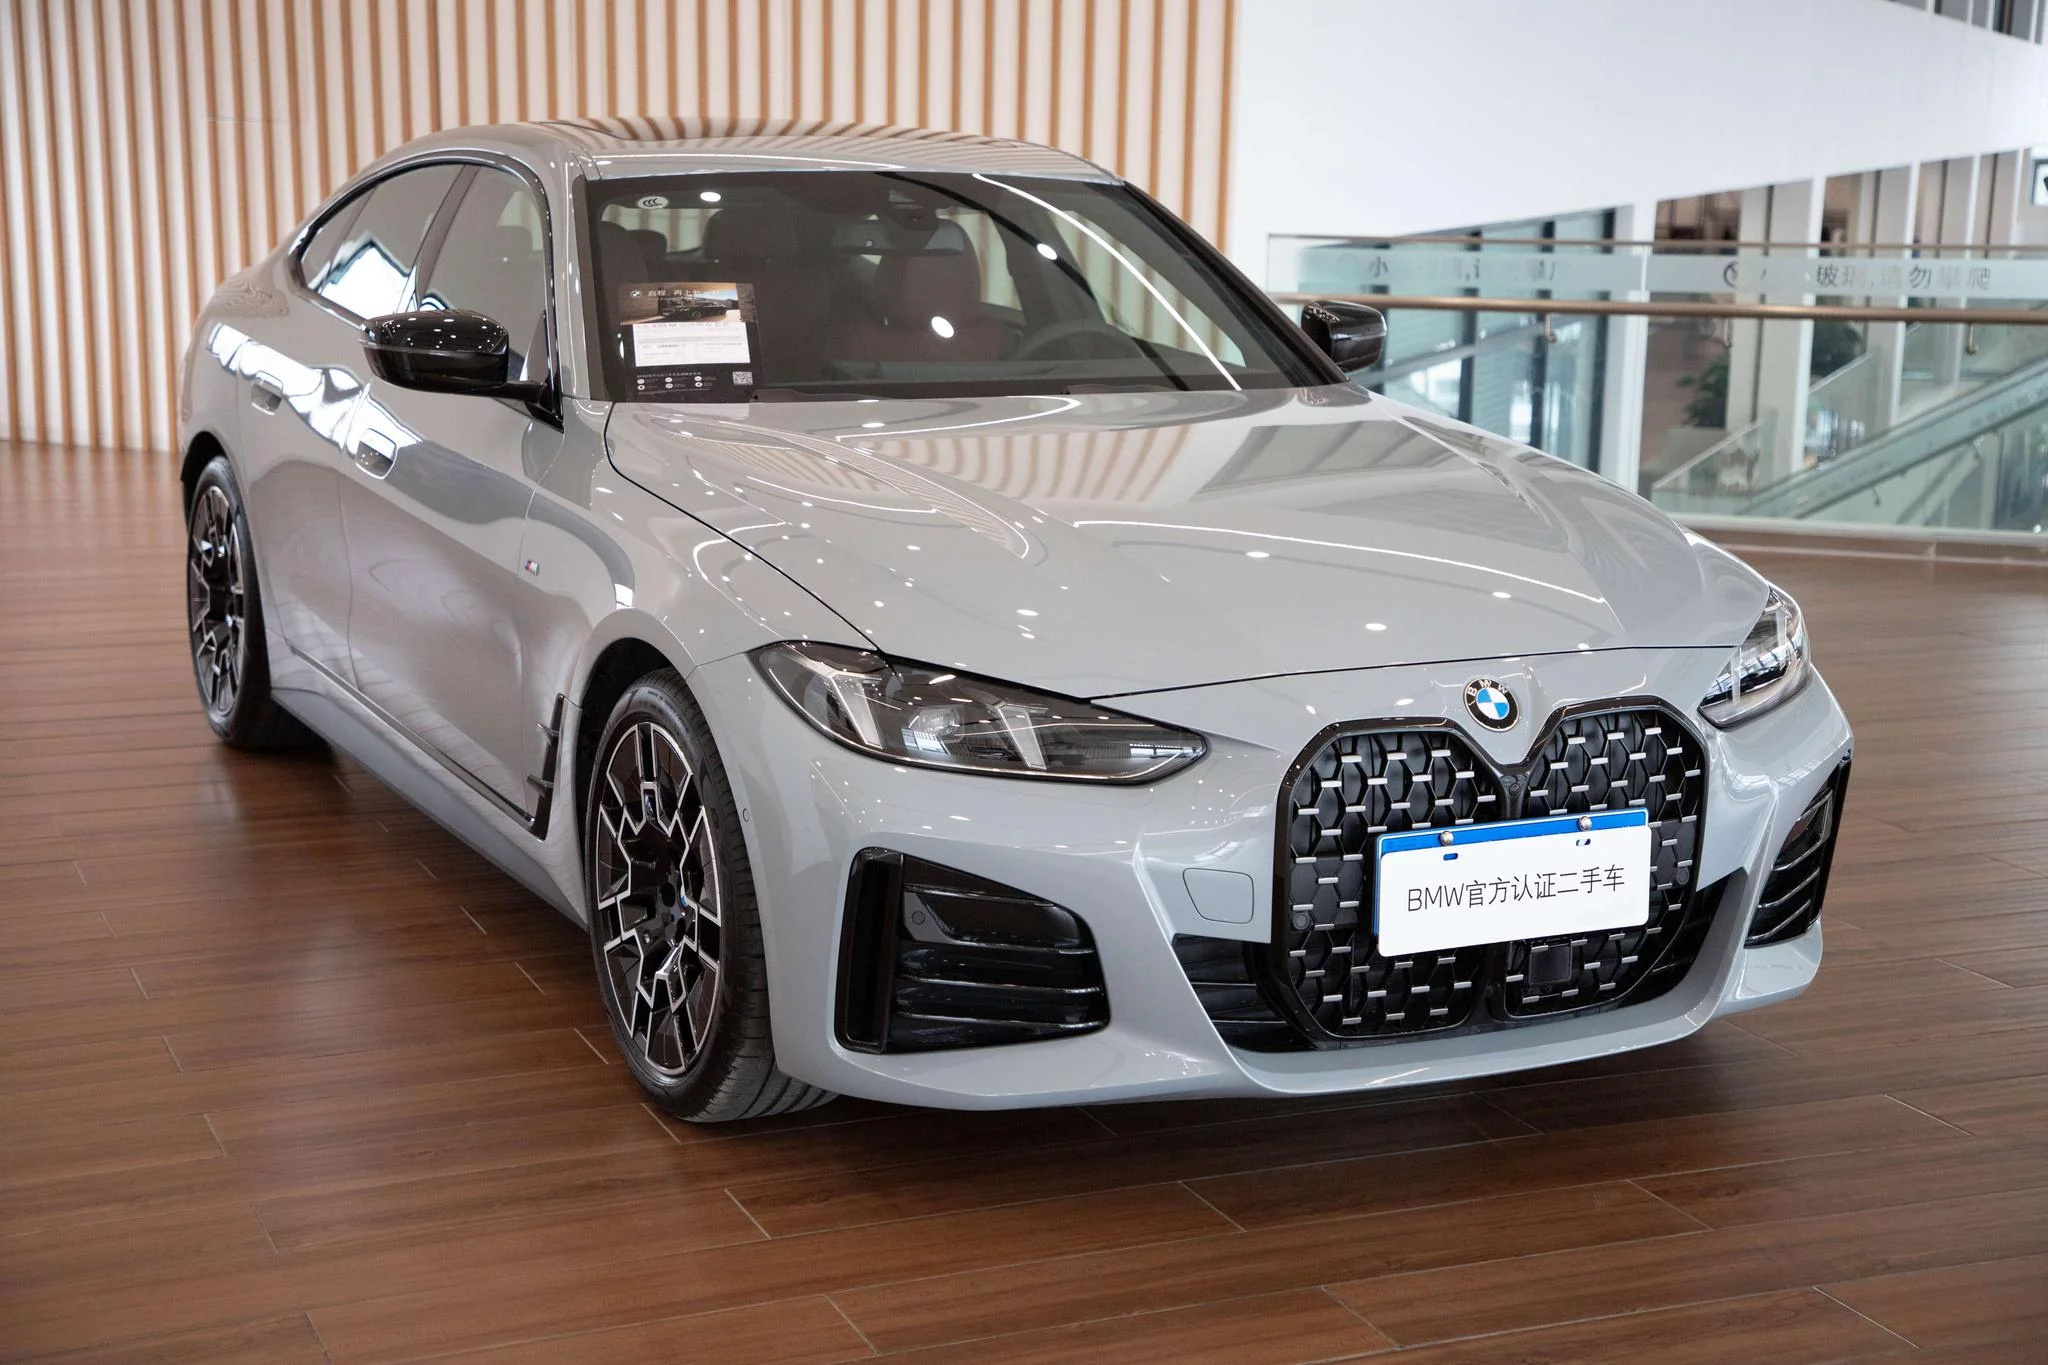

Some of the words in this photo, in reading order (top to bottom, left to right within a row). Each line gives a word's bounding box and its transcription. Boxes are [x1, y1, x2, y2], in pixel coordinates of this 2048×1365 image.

[1467, 679, 1509, 697] BMW
[1407, 864, 1625, 912] BMW官方认证二手车
